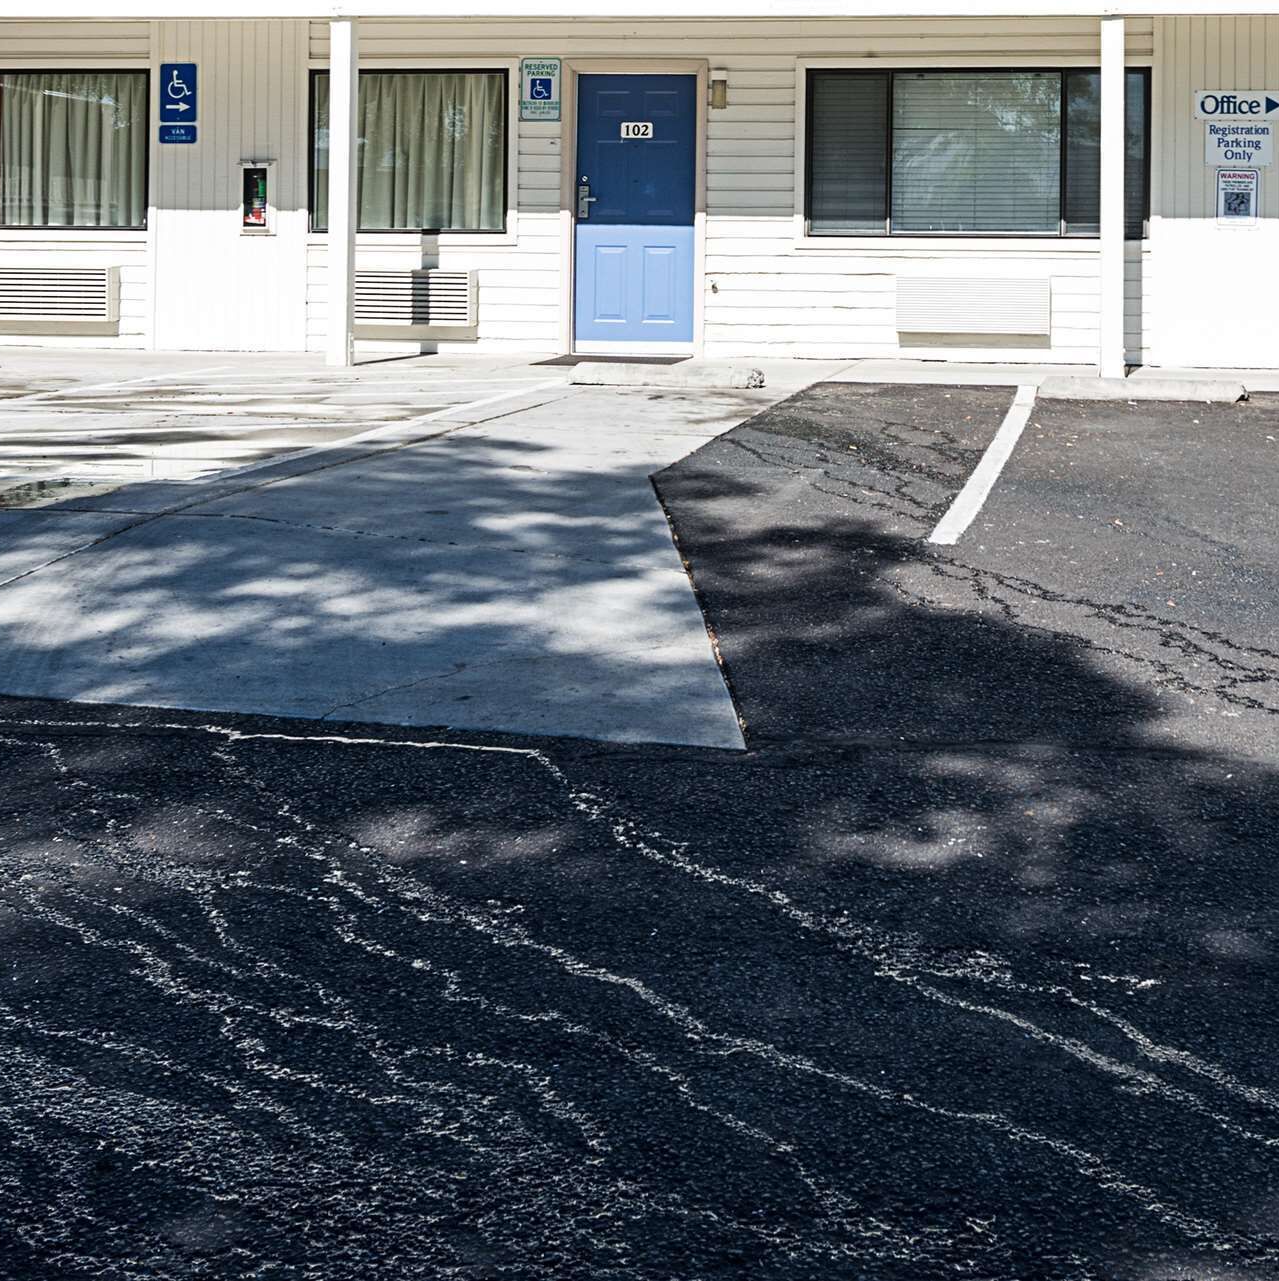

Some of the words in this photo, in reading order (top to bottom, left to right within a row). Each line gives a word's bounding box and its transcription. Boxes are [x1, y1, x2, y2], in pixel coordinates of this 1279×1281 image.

[524, 63, 558, 71] RESERVED
[1200, 94, 1261, 115] Office
[625, 124, 649, 136] 102
[1208, 124, 1270, 137] Registration
[1217, 137, 1261, 151] Parking
[1224, 149, 1253, 162] Only
